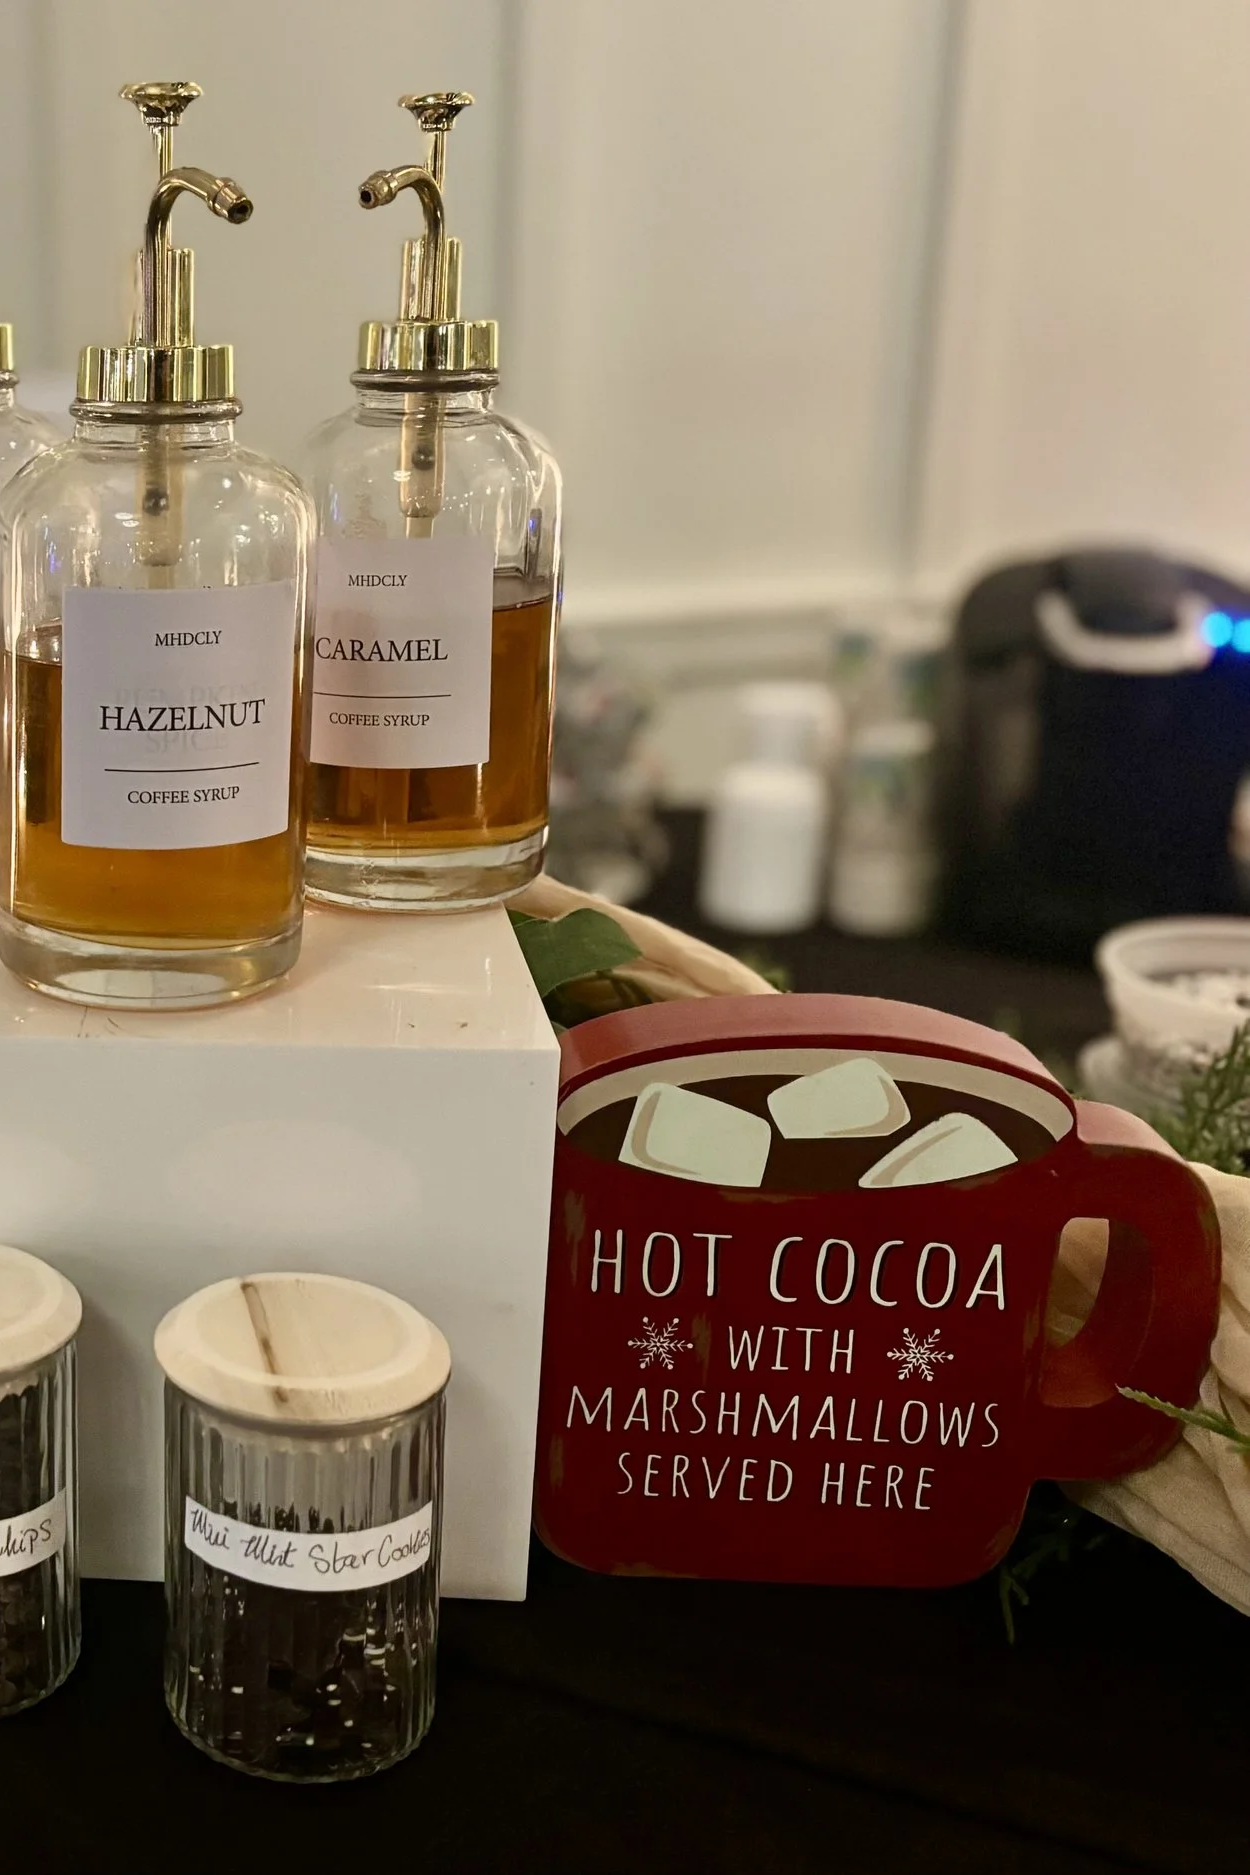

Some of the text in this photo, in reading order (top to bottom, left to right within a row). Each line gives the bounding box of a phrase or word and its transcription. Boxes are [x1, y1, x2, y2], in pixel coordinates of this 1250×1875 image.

[347, 573, 409, 588] MHDCLY
[154, 630, 223, 647] MHDCLY
[315, 636, 449, 662] CARAMEL
[99, 698, 266, 732] HAZELNUT
[329, 712, 431, 727] COFFEE SYRUP
[127, 786, 241, 805] COFFEE SYRUP
[591, 1229, 1006, 1311] HOT COCOA
[728, 1325, 855, 1374] WITH
[566, 1385, 1000, 1448] MARSHMALLOWS
[617, 1452, 936, 1511] SERVED HERE
[308, 1541, 375, 1574] Star
